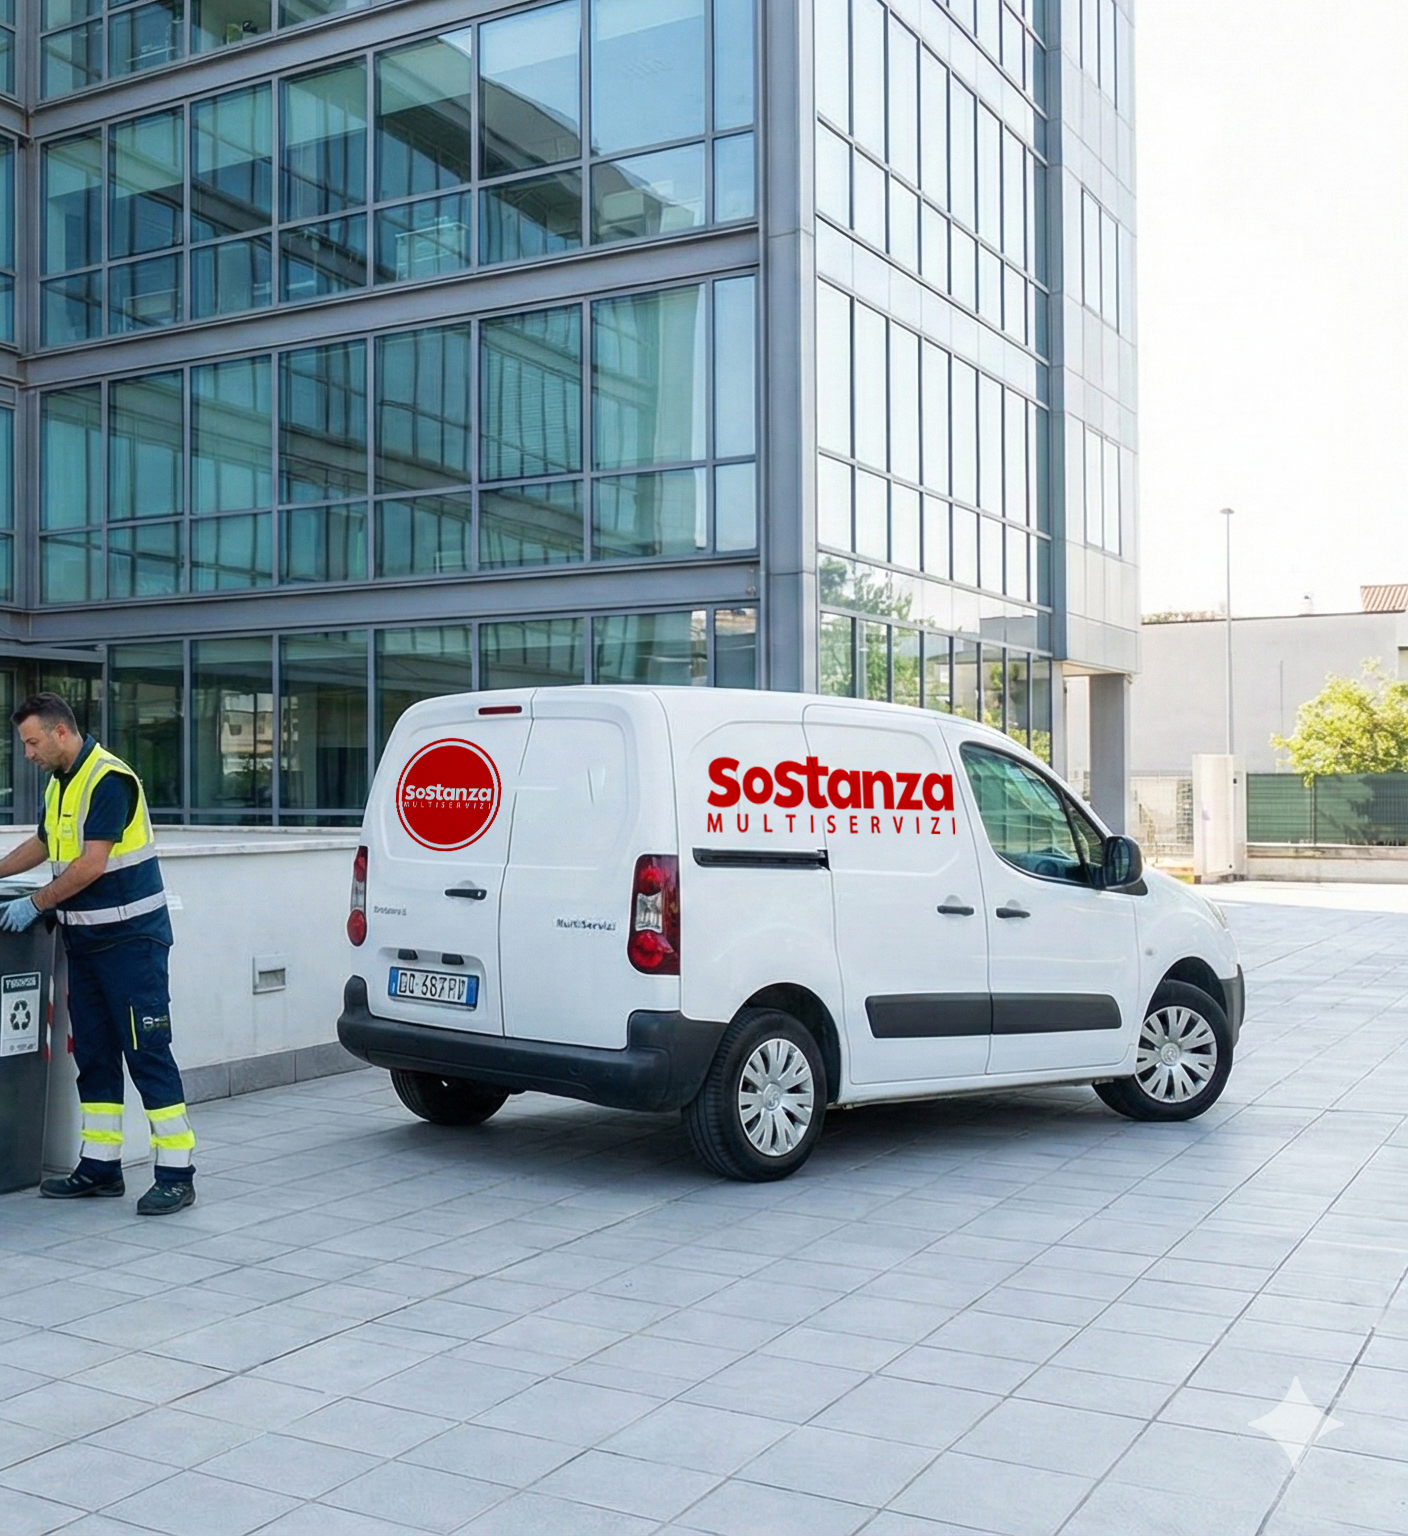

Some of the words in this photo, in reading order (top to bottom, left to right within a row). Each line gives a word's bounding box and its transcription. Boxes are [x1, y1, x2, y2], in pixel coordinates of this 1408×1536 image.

[404, 784, 492, 801] SoStanza
[707, 756, 955, 811] SoStanza
[403, 801, 492, 809] MULTISERVIZI
[707, 813, 956, 835] MULTISERVIZI
